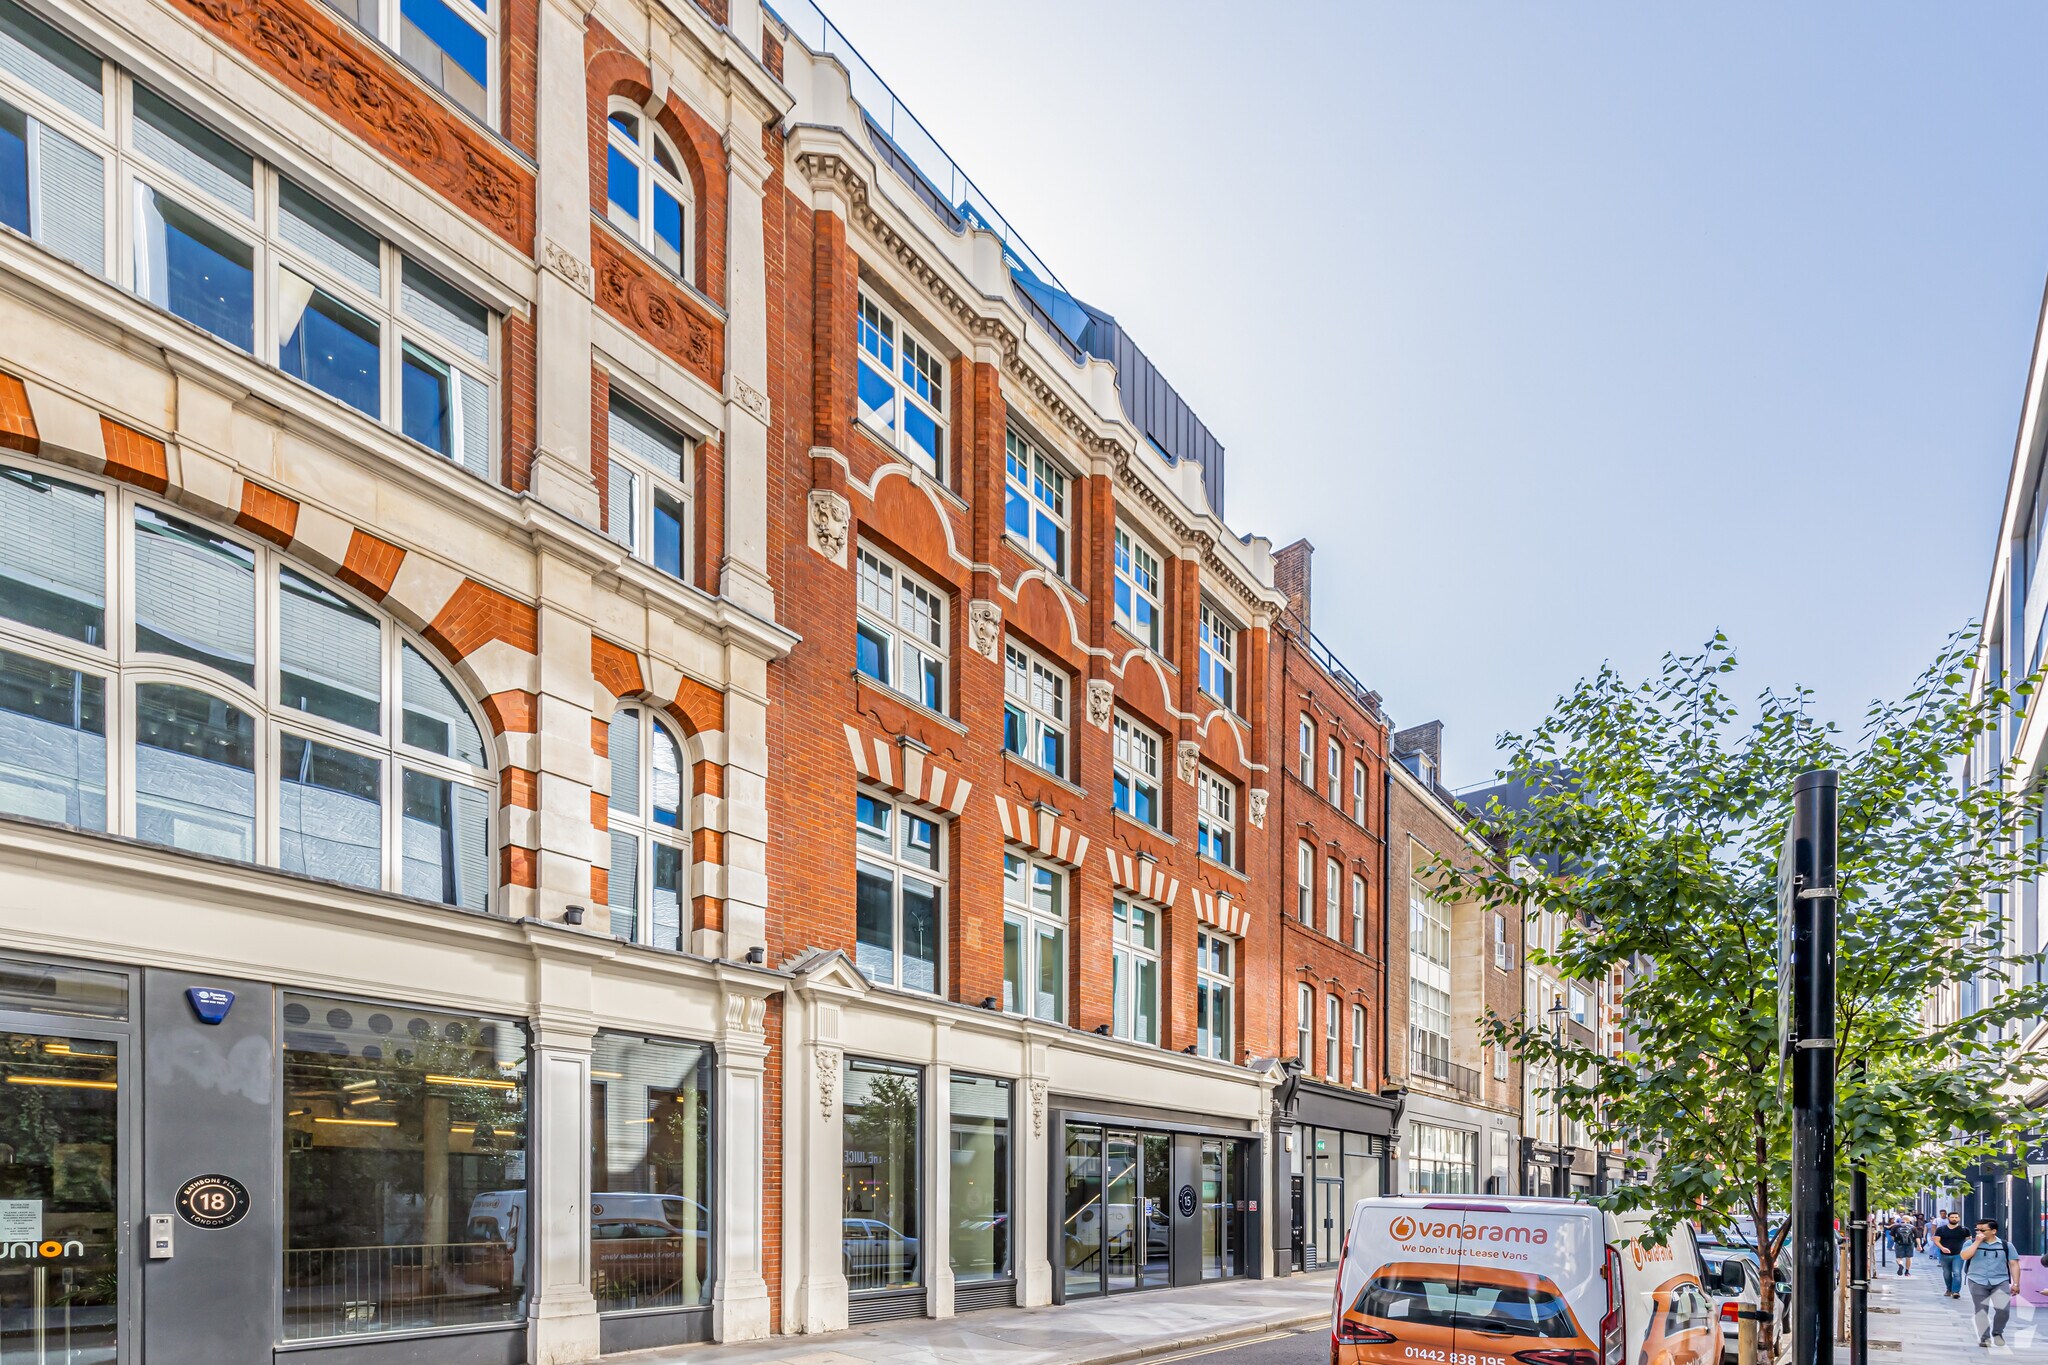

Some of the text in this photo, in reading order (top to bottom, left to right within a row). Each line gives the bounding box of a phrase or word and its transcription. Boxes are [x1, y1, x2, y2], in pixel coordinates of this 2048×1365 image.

[184, 1178, 242, 1195] RATHBONE PLACE
[200, 1193, 225, 1210] 18
[190, 1214, 224, 1226] LONDON
[1419, 1222, 1548, 1245] vanarama
[1402, 1244, 1528, 1261] We Don't Just Lease Vans
[1405, 1347, 1506, 1365] 01442 838 195
